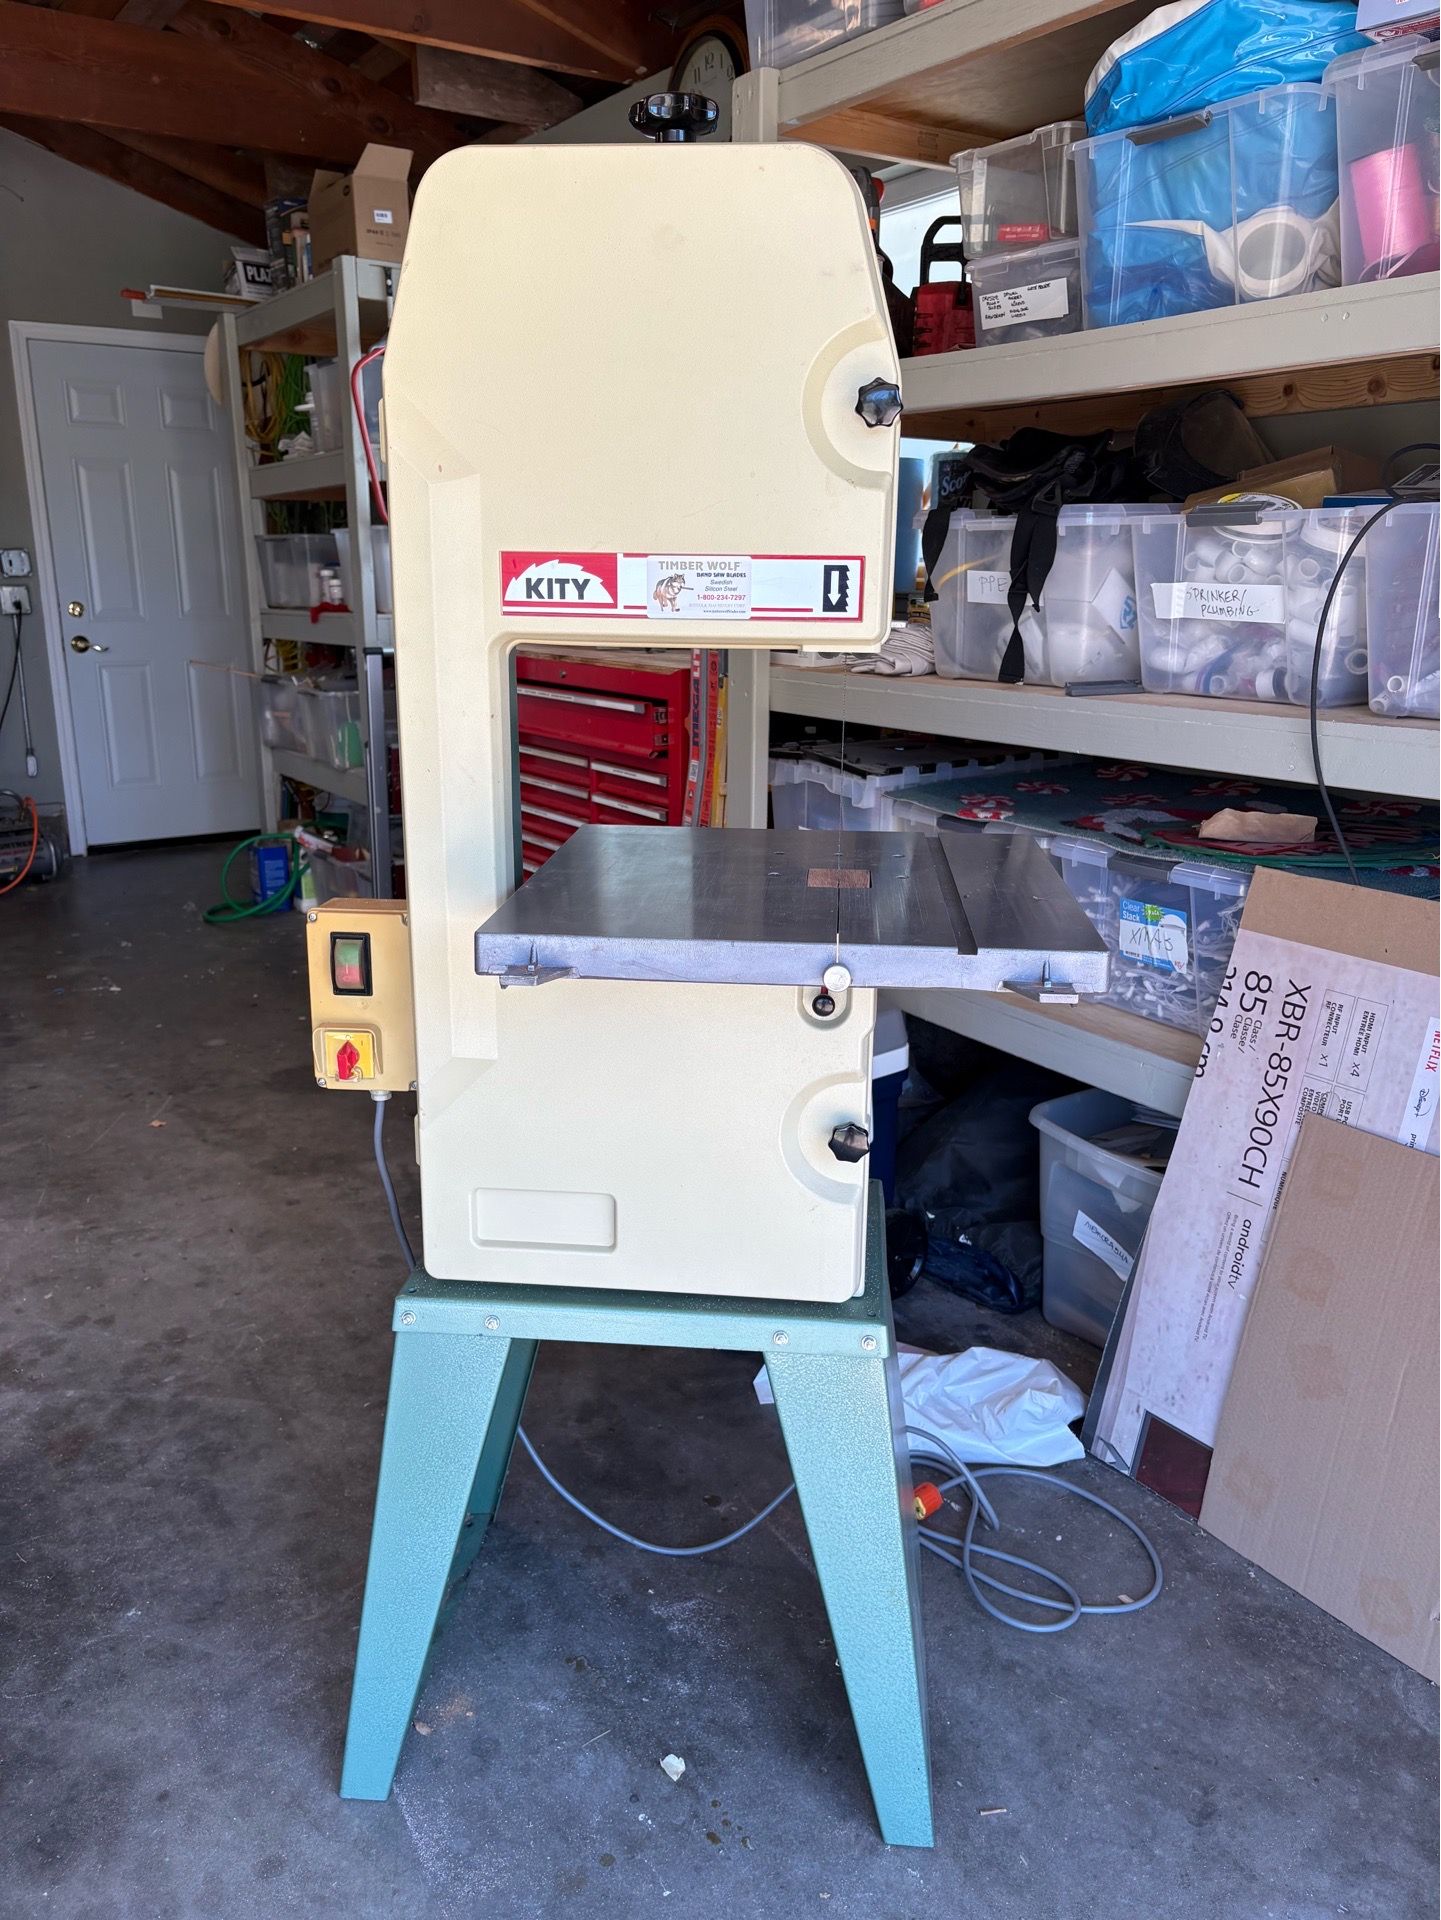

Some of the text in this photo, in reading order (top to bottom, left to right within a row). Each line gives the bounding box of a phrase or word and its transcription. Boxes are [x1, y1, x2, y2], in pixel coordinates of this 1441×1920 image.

[658, 560, 741, 572] TIMBER WOLF
[525, 577, 591, 601] KITY
[1201, 604, 1260, 617] PLUMBING
[1122, 900, 1140, 912] Clear
[1122, 911, 1140, 921] Stack
[1239, 971, 1272, 1015] 85
[1326, 1001, 1332, 1009] RF
[1230, 1014, 1243, 1039] Clase
[1321, 1002, 1337, 1046] CONNECTEUR
[1331, 1004, 1344, 1034] RF INPUT
[1361, 1012, 1376, 1054] HDMI INPUT
[1353, 1037, 1363, 1056] HDMI
[1238, 979, 1312, 1188] XBR-85X90CH
[1295, 1087, 1309, 1126] COMPOSITE
[1310, 1091, 1321, 1112] VIDEO
[1337, 1099, 1347, 1117] PORT
[1343, 1101, 1353, 1115] USB
